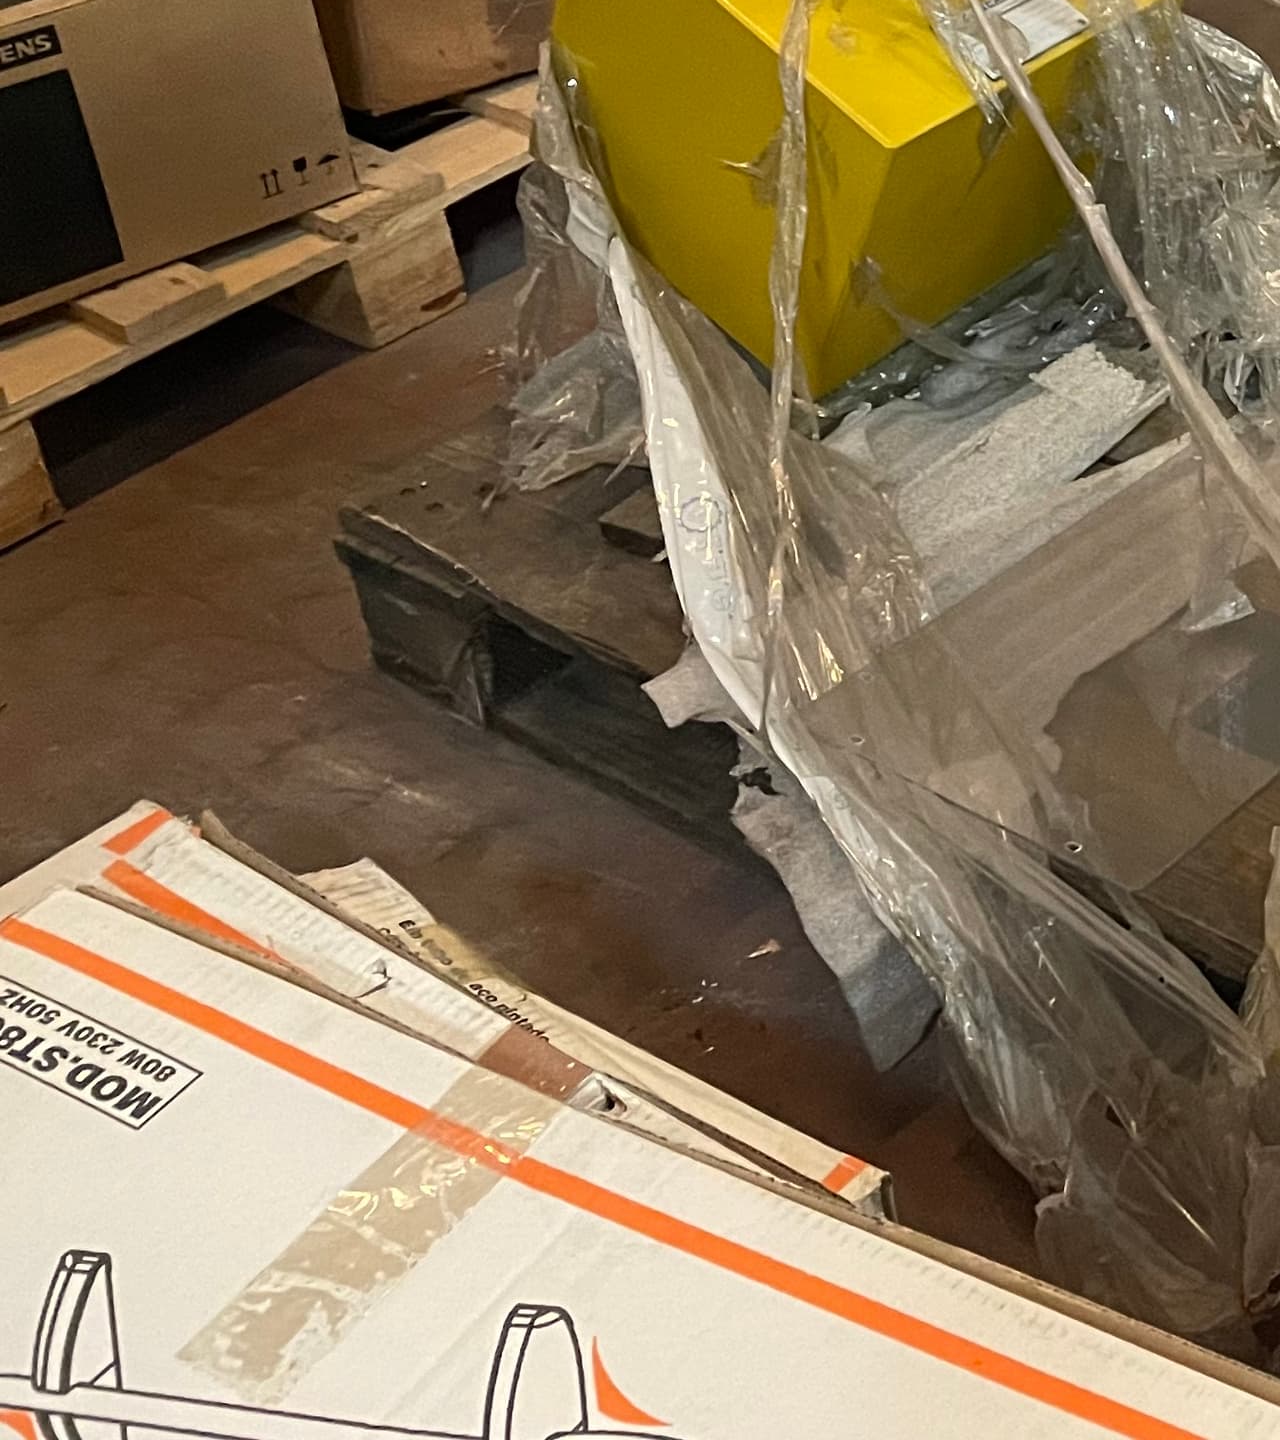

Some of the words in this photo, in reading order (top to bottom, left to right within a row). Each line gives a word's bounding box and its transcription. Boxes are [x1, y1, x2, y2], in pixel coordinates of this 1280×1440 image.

[0, 987, 61, 1025] 50HZ
[56, 1019, 125, 1055] 230V
[0, 1016, 163, 1120] MOD.ST8
[117, 1049, 177, 1083] 80W
